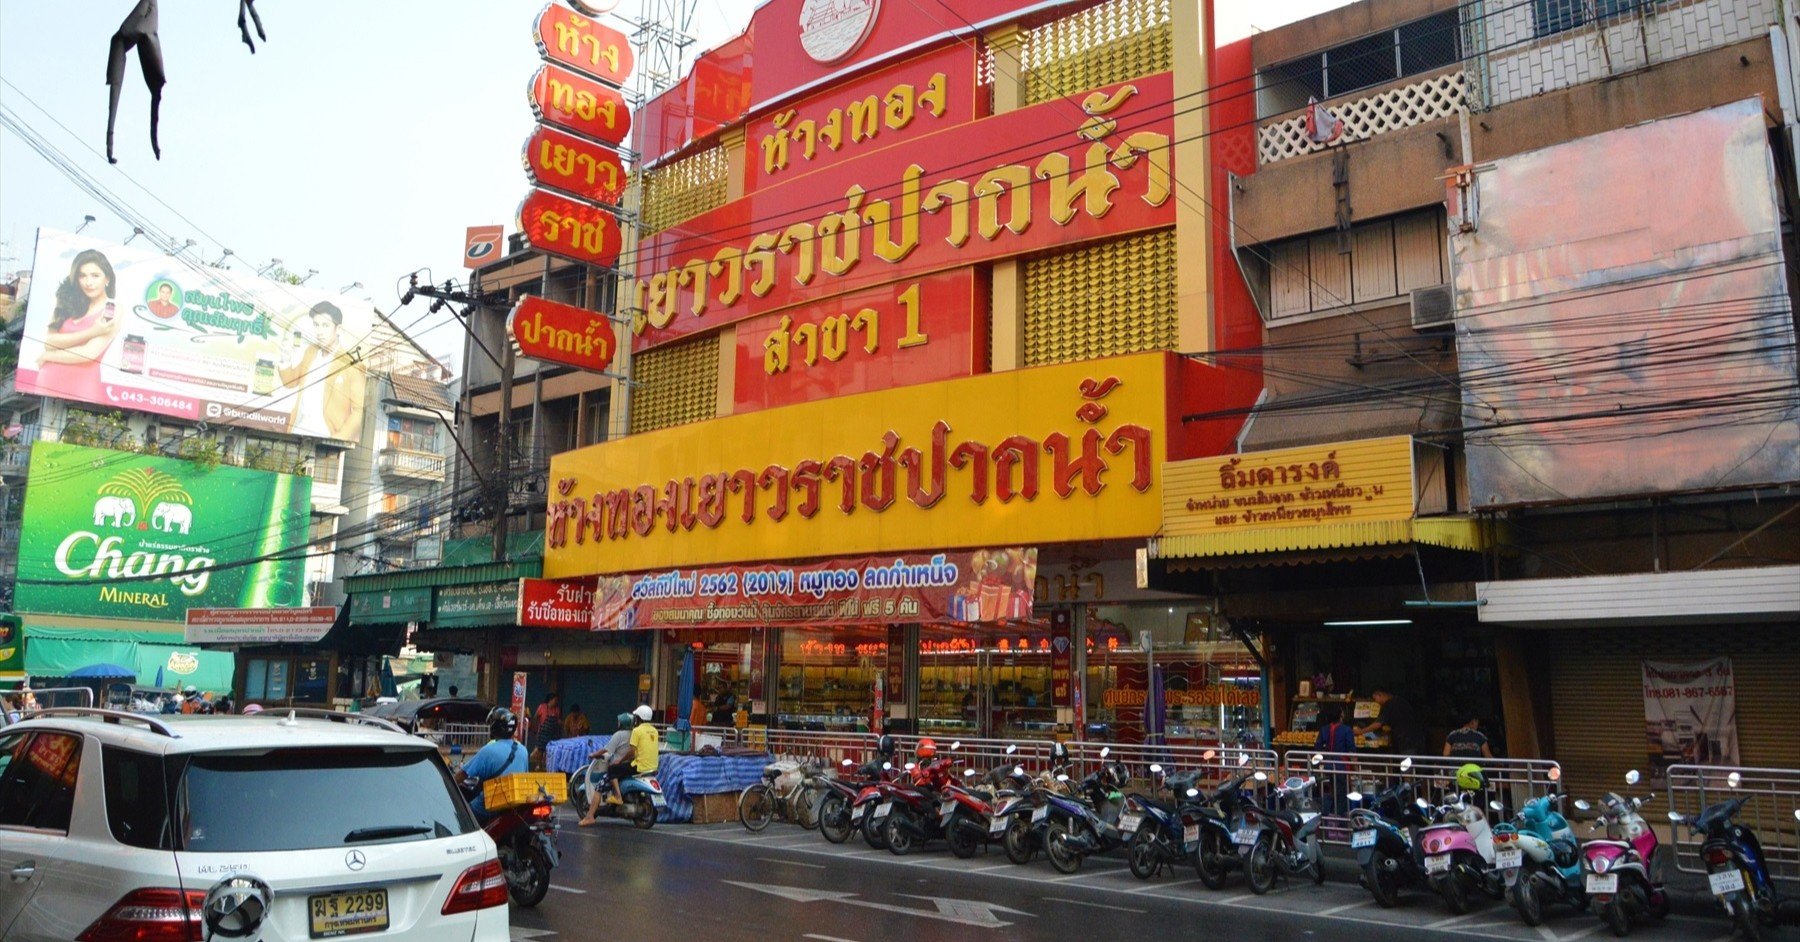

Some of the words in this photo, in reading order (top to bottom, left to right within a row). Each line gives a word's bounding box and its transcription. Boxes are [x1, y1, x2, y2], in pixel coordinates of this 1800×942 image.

[554, 13, 619, 74] ห้าง
[548, 77, 616, 131] ทอง
[760, 71, 948, 175] ห้างทอง
[540, 138, 618, 193] เยาว
[540, 210, 606, 256] ราช
[633, 84, 1172, 337] เยาวราชปากน้ำ
[184, 288, 255, 316] สมุนไพร
[521, 311, 608, 361] ปากน้ำ
[762, 307, 879, 376] สาขา
[896, 282, 929, 349] 1
[121, 390, 193, 411] 043-306484
[223, 407, 287, 426] @bunditworld
[546, 376, 1153, 549] ห้างทองเยาวราชปากน้ำ
[54, 530, 217, 596] Chang
[632, 569, 697, 600] สวัสดีปีใหม่
[699, 572, 738, 596] 2562
[742, 569, 794, 597] (2019)
[799, 568, 859, 599] หมูทอง
[862, 553, 958, 590] ลดกำเหน็จ
[863, 599, 880, 615] ฟรี
[884, 600, 896, 615] 5
[899, 598, 920, 615] คัน
[345, 893, 384, 914] 2299
